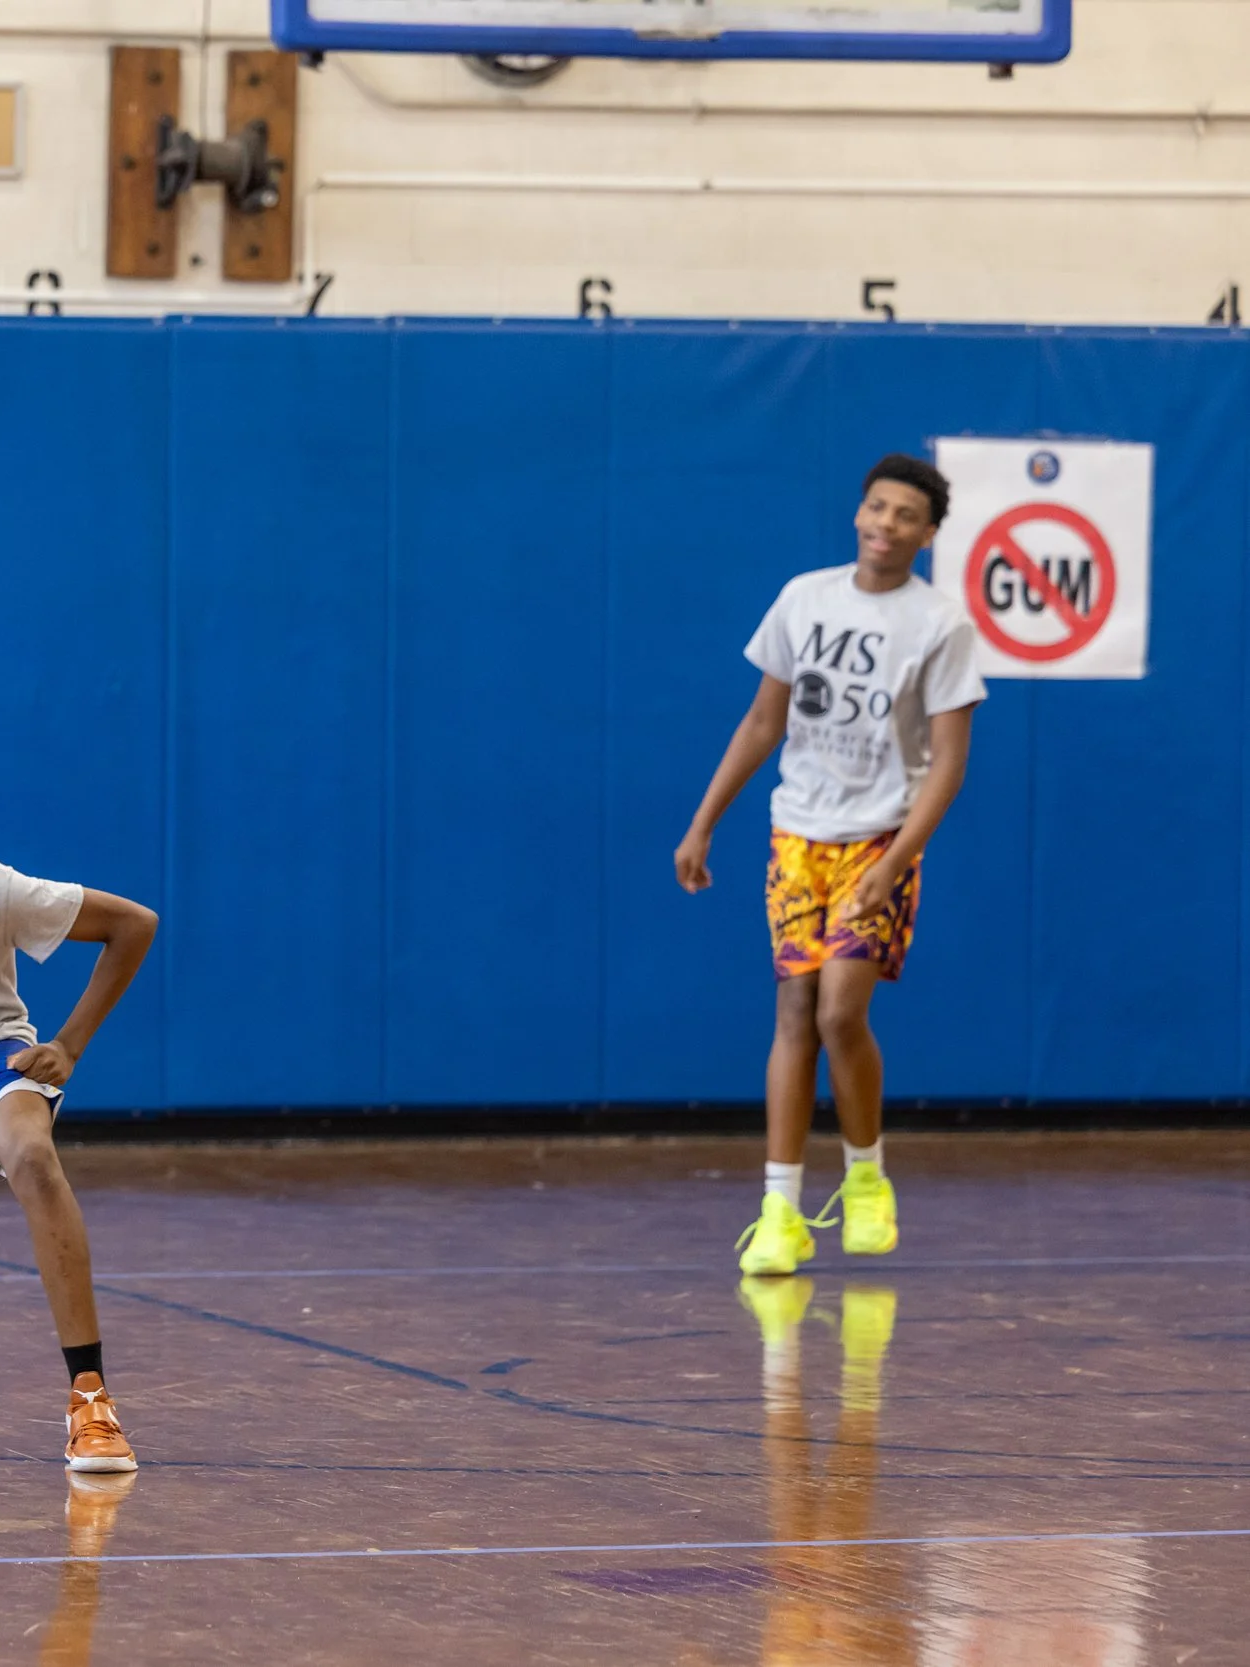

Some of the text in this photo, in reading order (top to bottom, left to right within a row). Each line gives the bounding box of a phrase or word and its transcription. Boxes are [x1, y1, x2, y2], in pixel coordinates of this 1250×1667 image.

[306, 273, 335, 318] 7
[579, 278, 613, 319] 6
[862, 280, 896, 323] 5
[1207, 284, 1242, 328] 4
[983, 556, 1092, 615] GUM
[798, 621, 885, 676] MS
[832, 683, 892, 726] 50
